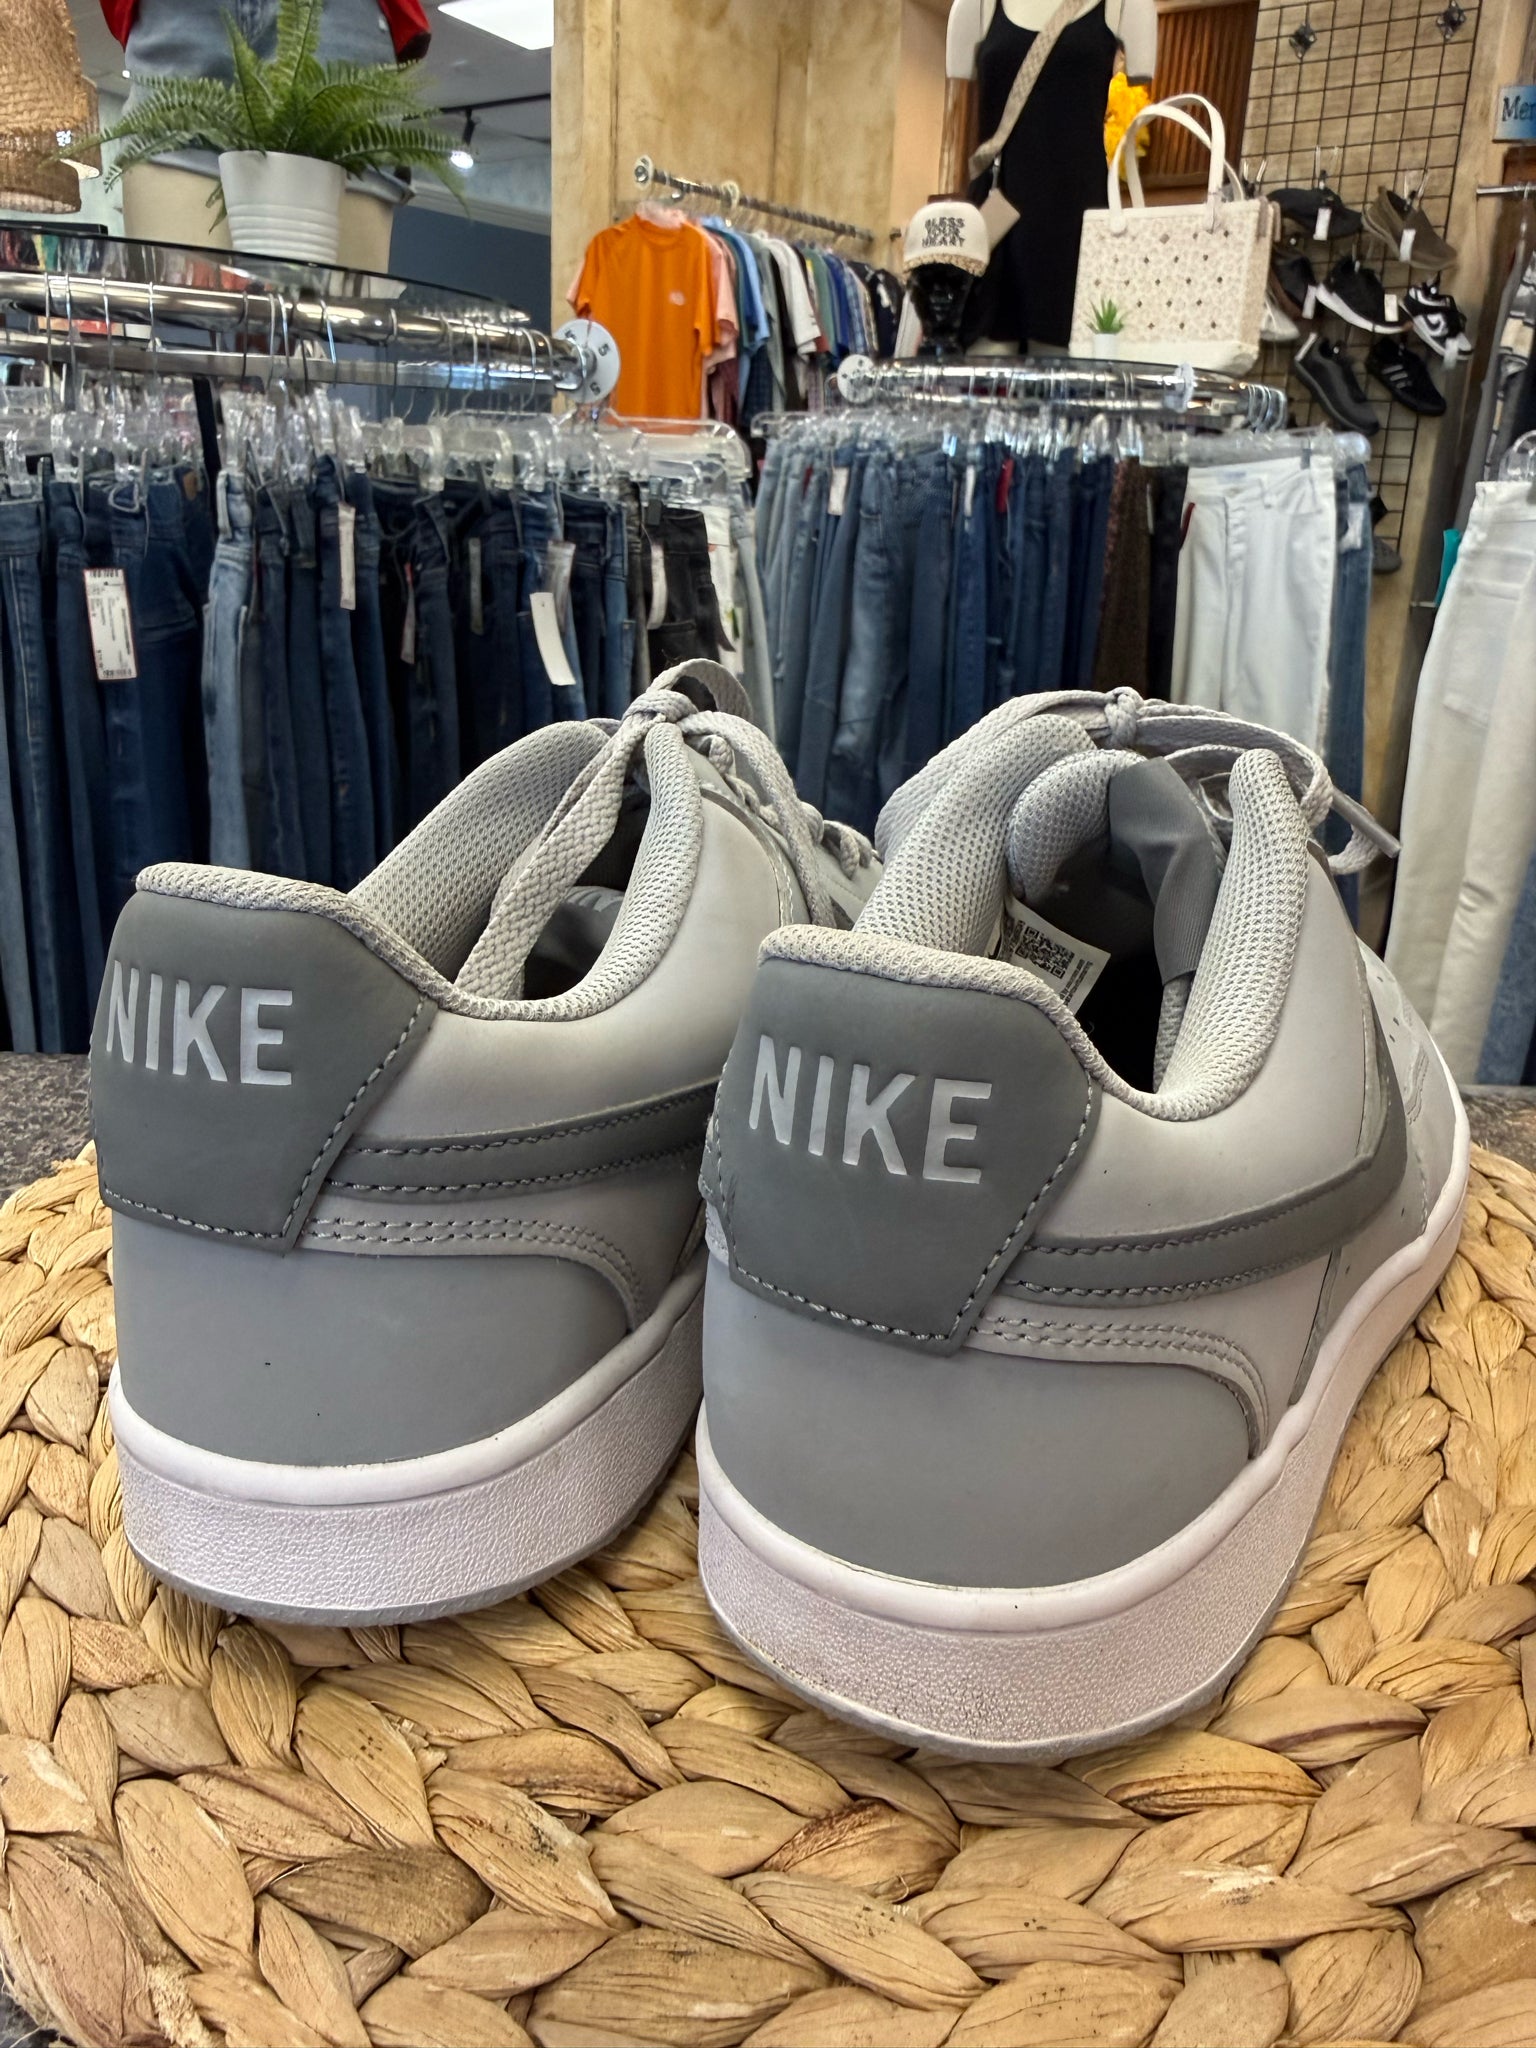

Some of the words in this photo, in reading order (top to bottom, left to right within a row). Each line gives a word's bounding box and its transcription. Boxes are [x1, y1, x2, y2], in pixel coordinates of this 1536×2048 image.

[922, 237, 965, 248] HEART
[925, 216, 966, 228] BLESS
[106, 960, 292, 1085] NIKE
[749, 1035, 992, 1184] NIKE
